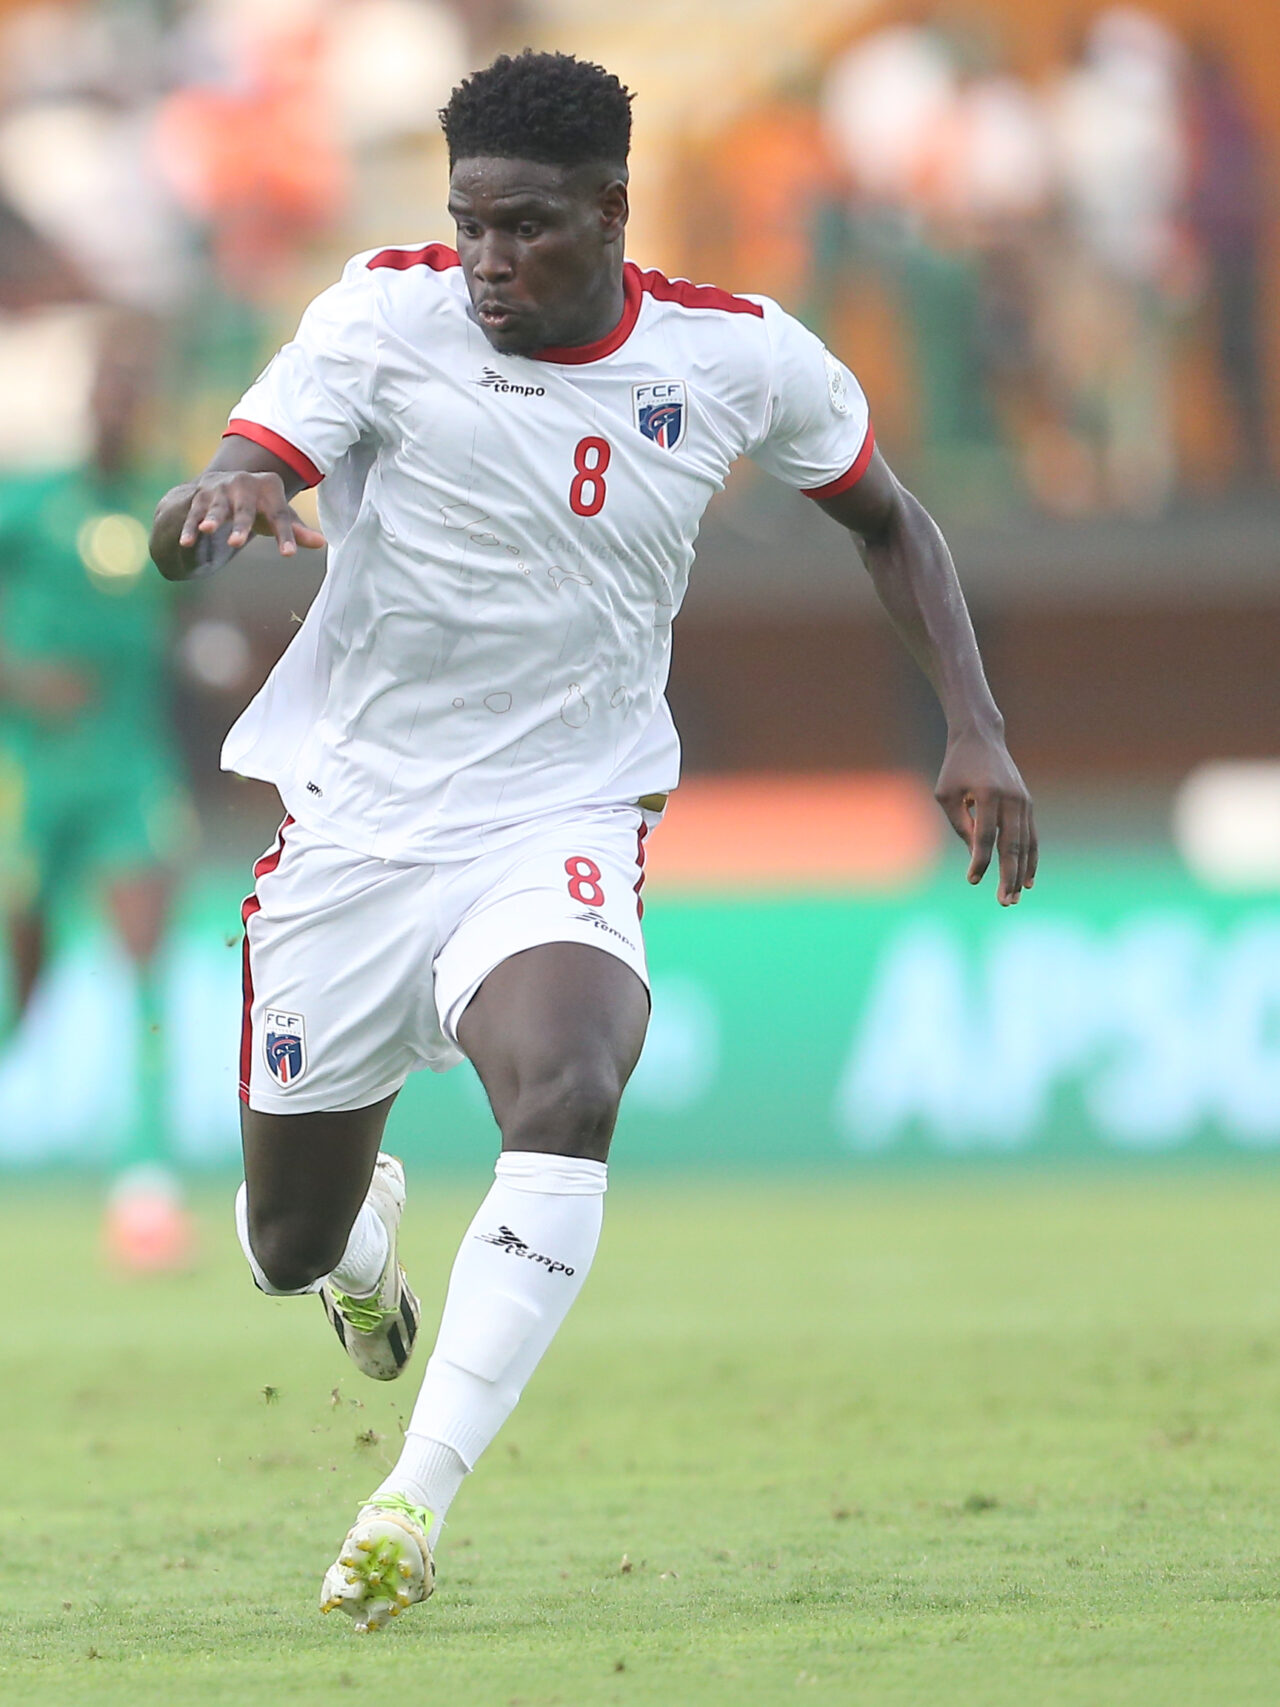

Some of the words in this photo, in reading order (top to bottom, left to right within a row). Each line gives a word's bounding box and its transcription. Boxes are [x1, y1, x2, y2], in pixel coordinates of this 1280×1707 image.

[493, 383, 546, 397] tempo
[637, 385, 681, 400] FCF
[569, 436, 611, 517] 8
[564, 856, 605, 907] 8
[594, 921, 636, 951] tempo
[267, 1013, 300, 1028] FCF
[504, 1244, 575, 1276] tempo
